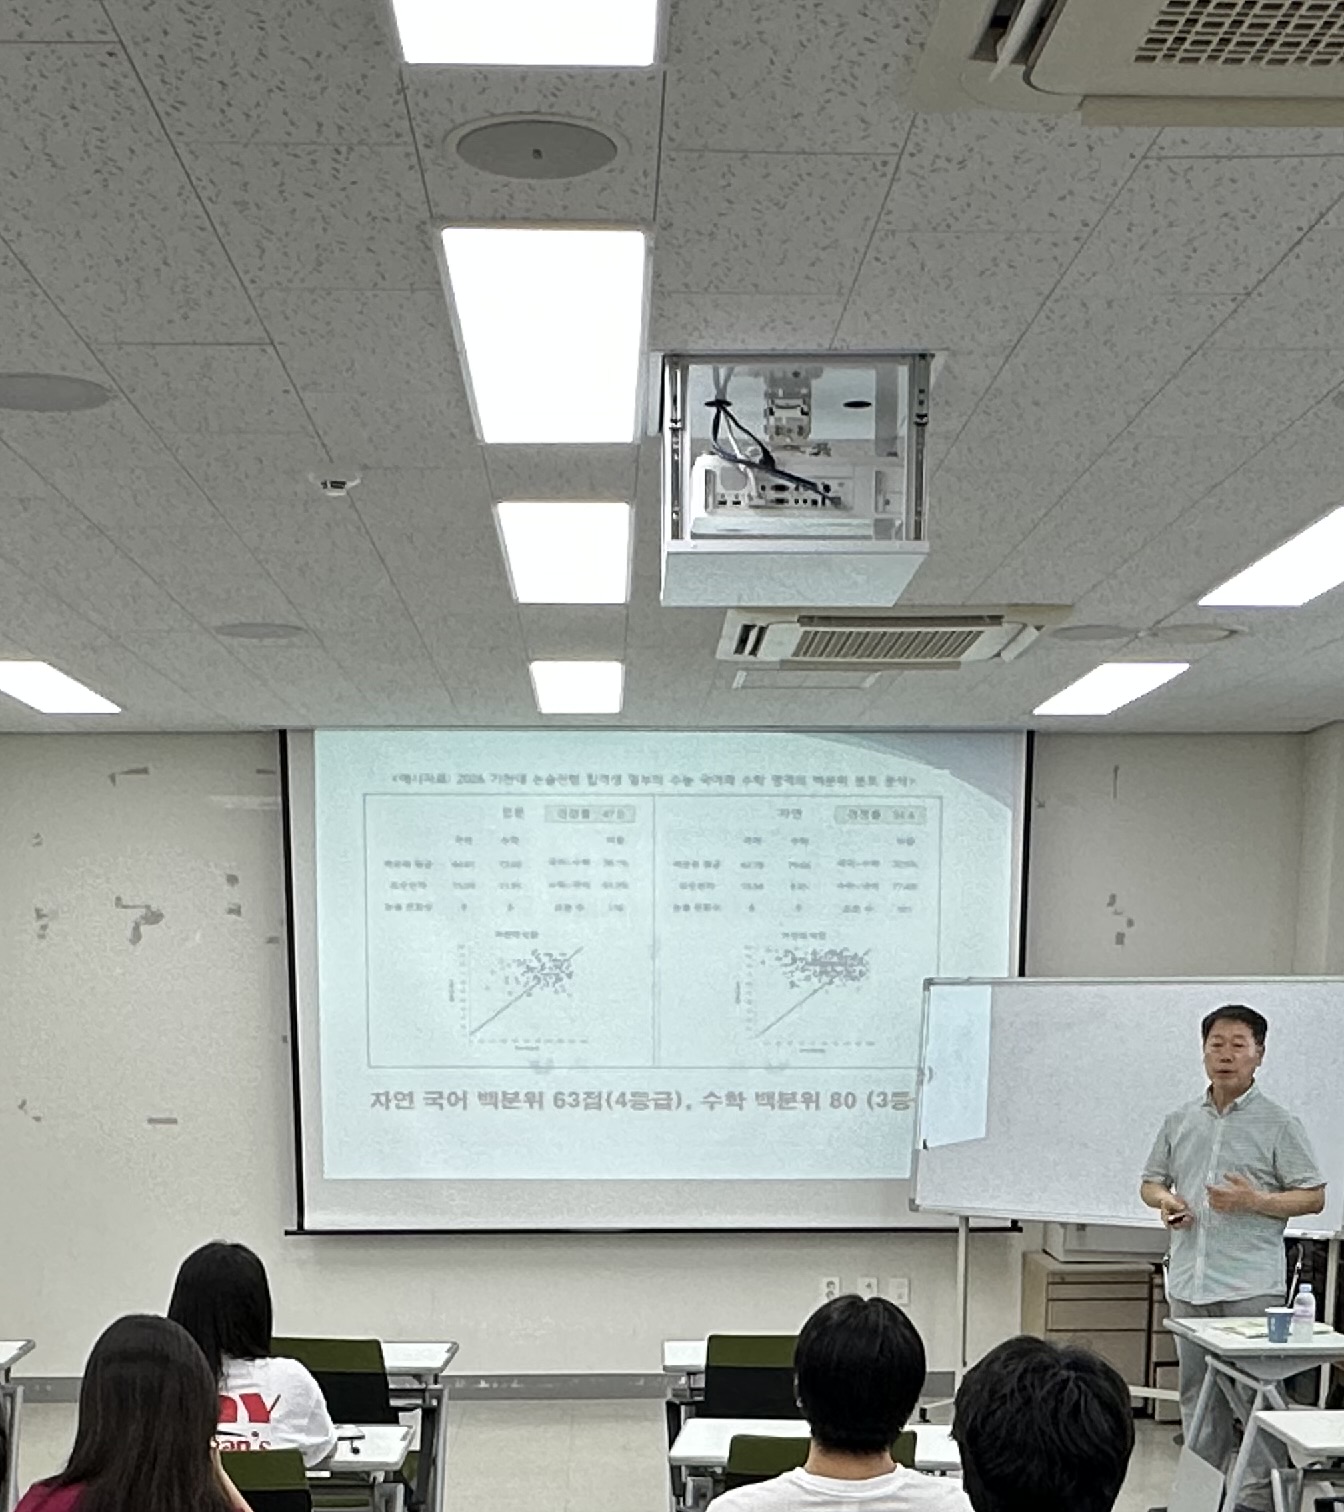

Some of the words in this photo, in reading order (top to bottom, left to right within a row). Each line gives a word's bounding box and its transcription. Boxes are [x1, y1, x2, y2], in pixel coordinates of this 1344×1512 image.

[370, 1090, 415, 1111] 자연
[422, 1090, 468, 1111] 국어
[477, 1090, 545, 1111] 백분위
[702, 1090, 747, 1111] 수학
[755, 1090, 822, 1112] 백분위
[828, 1091, 857, 1110] 80
